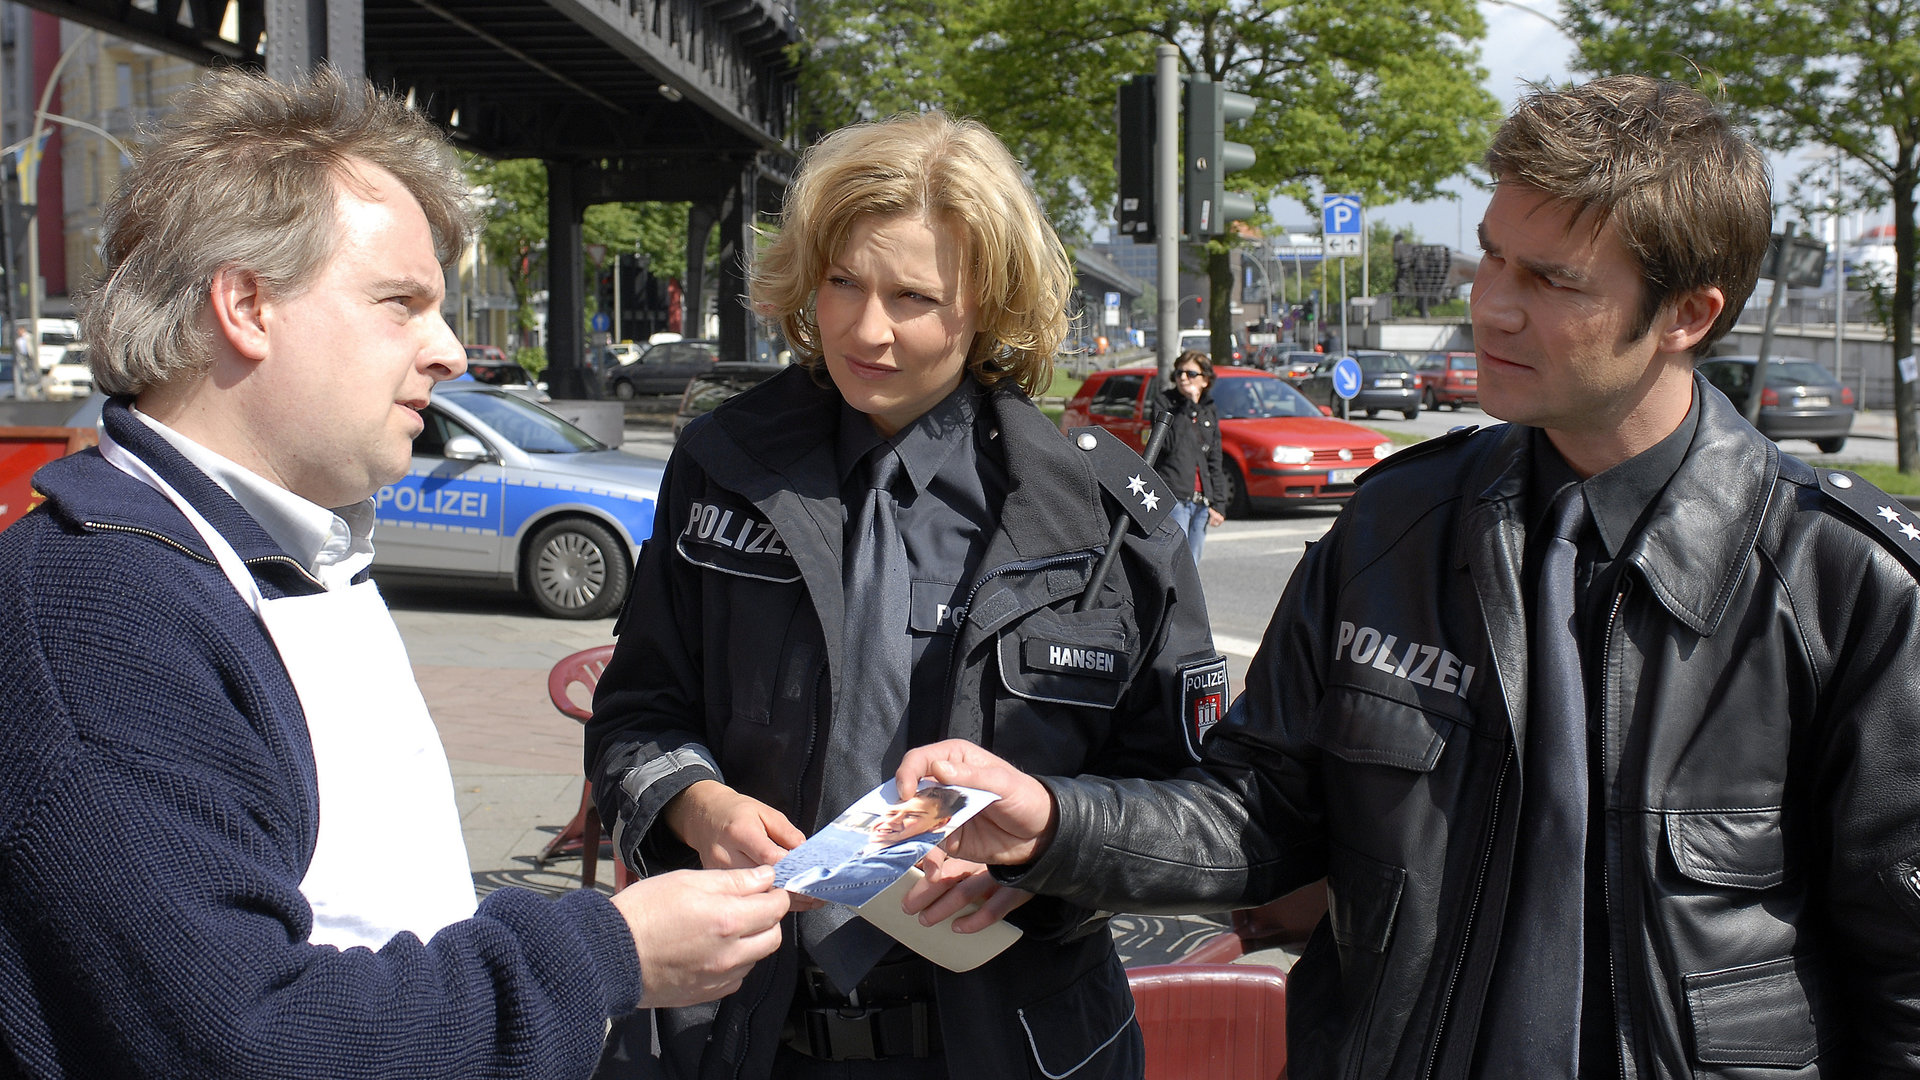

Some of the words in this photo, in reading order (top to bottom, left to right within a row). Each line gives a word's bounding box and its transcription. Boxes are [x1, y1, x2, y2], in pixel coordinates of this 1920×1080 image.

[1333, 205, 1352, 232] P
[376, 485, 488, 518] POLIZEI
[1049, 645, 1115, 673] HANSEN
[1335, 620, 1476, 699] POLIZEI
